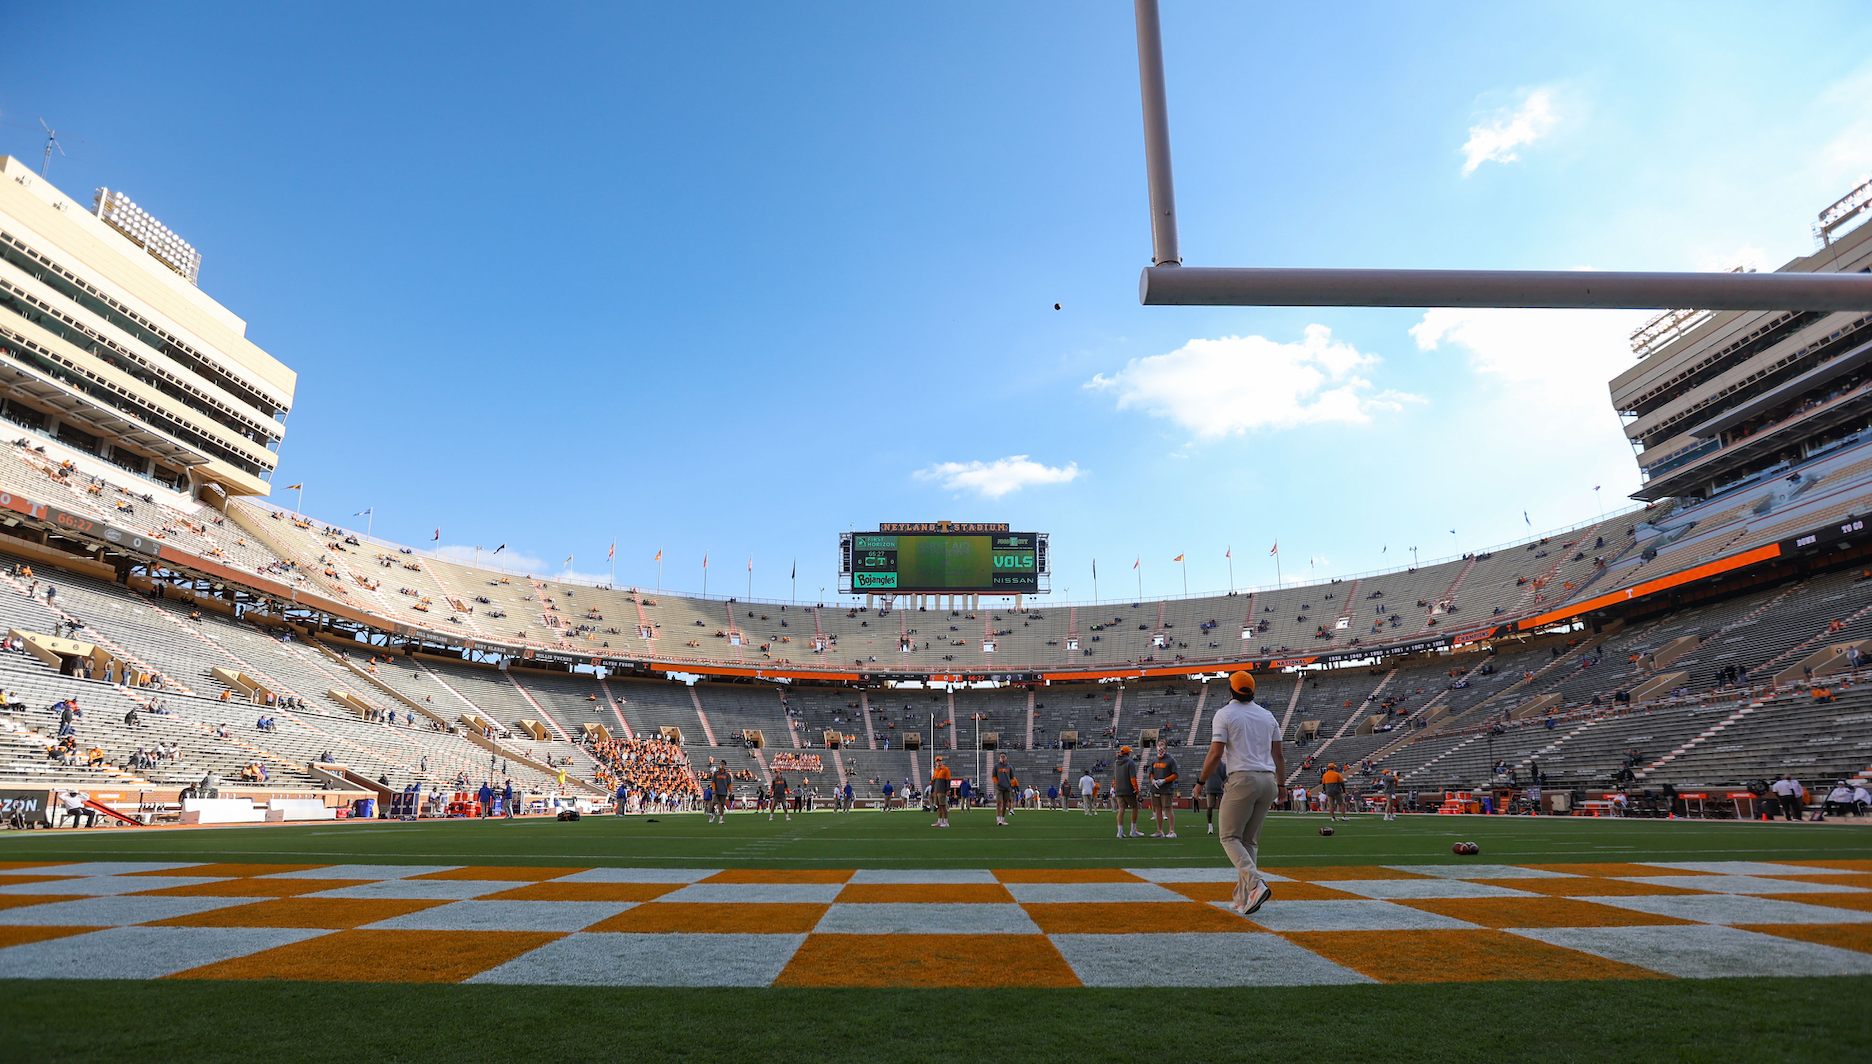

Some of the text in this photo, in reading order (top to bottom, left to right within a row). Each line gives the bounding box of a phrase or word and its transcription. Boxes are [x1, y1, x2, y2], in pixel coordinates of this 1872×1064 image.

[27, 501, 45, 518] T
[58, 513, 93, 531] 66:27
[883, 523, 936, 531] NEYLAND
[953, 523, 1006, 532] STADIUM
[919, 541, 971, 550] FIRST AID
[993, 556, 1033, 568] VOLS
[857, 574, 895, 586] Bojangles
[1457, 630, 1490, 642] CHAMPIONS
[1276, 659, 1307, 667] NATIONAL
